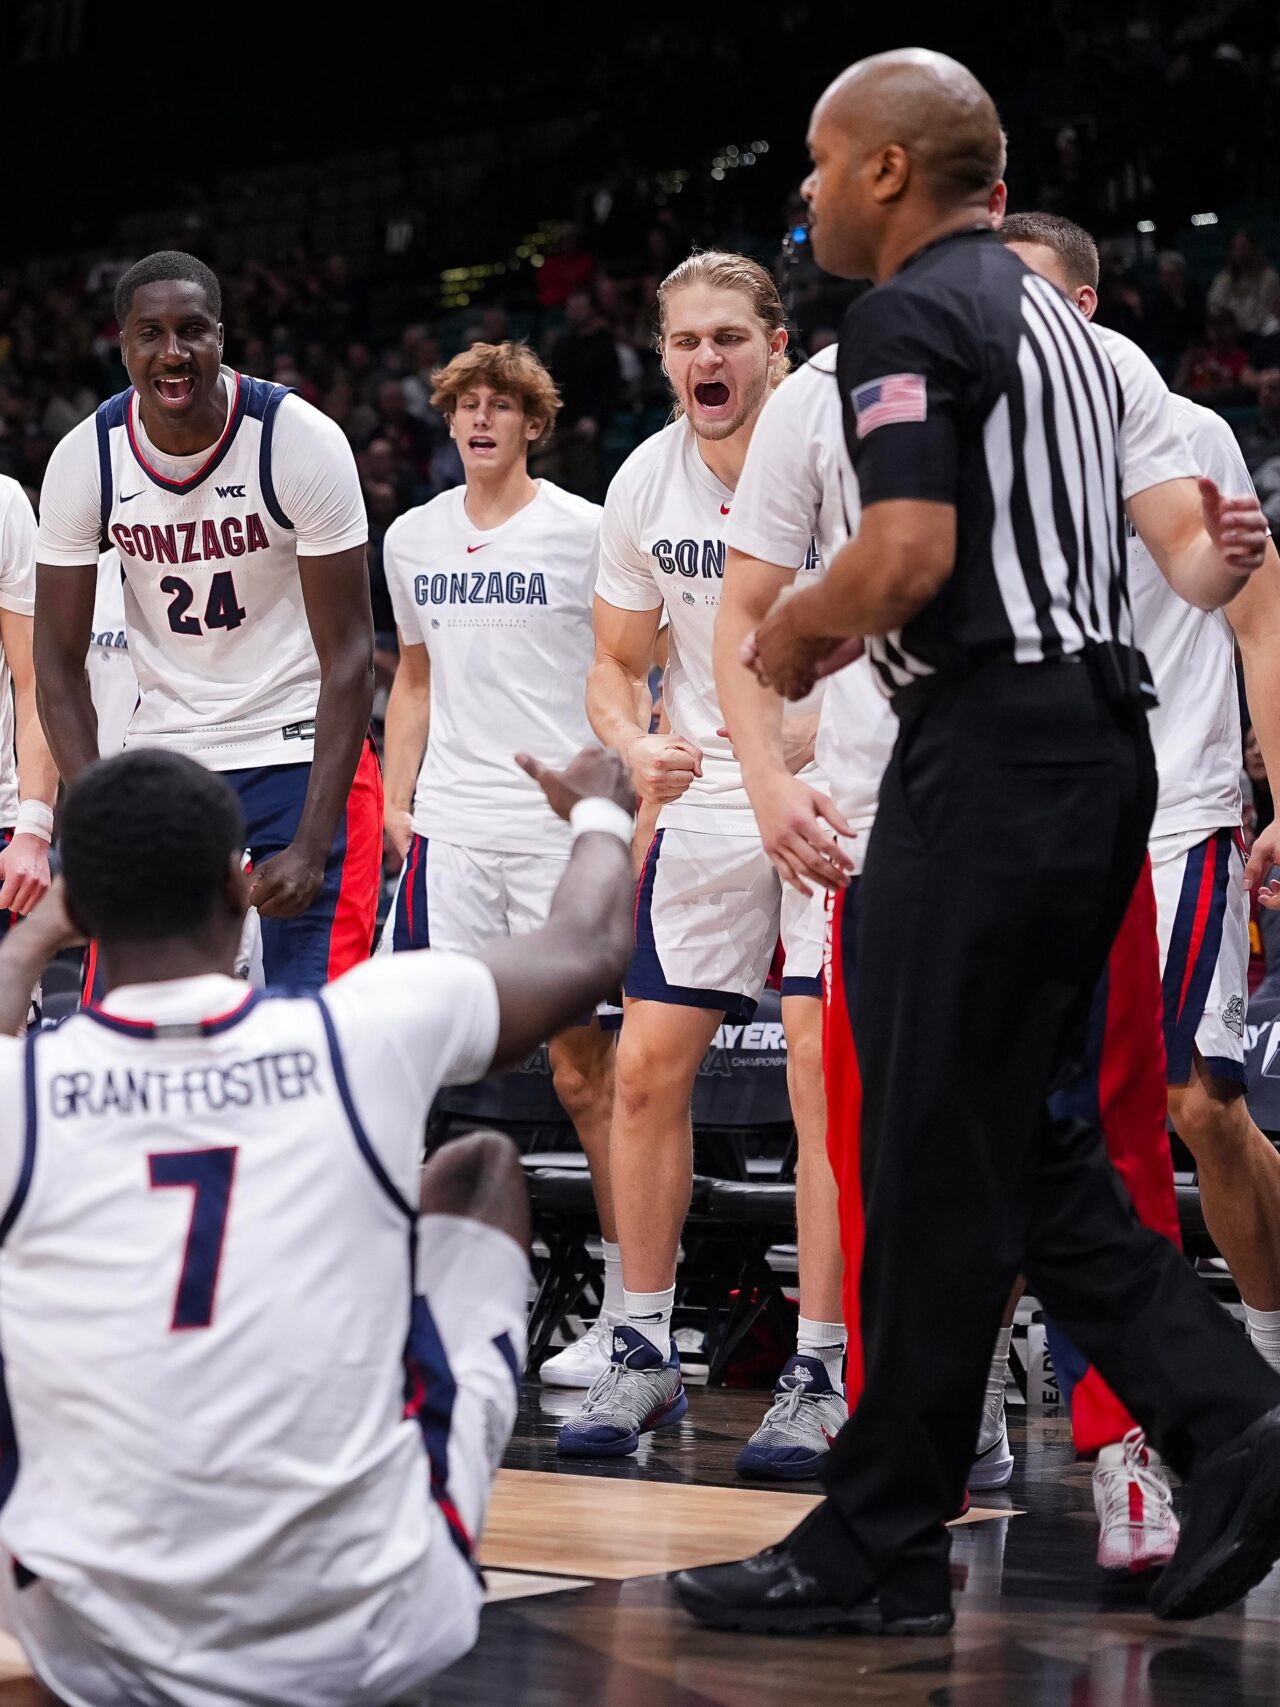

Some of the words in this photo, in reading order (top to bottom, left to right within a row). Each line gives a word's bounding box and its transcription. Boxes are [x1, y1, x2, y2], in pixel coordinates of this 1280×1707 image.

[215, 485, 247, 498] WCC
[111, 512, 270, 564] GONZAGA
[160, 570, 247, 636] 24
[414, 572, 548, 606] GONZAGA
[50, 1051, 323, 1119] GRANT-FOSTER
[148, 1146, 239, 1331] 7
